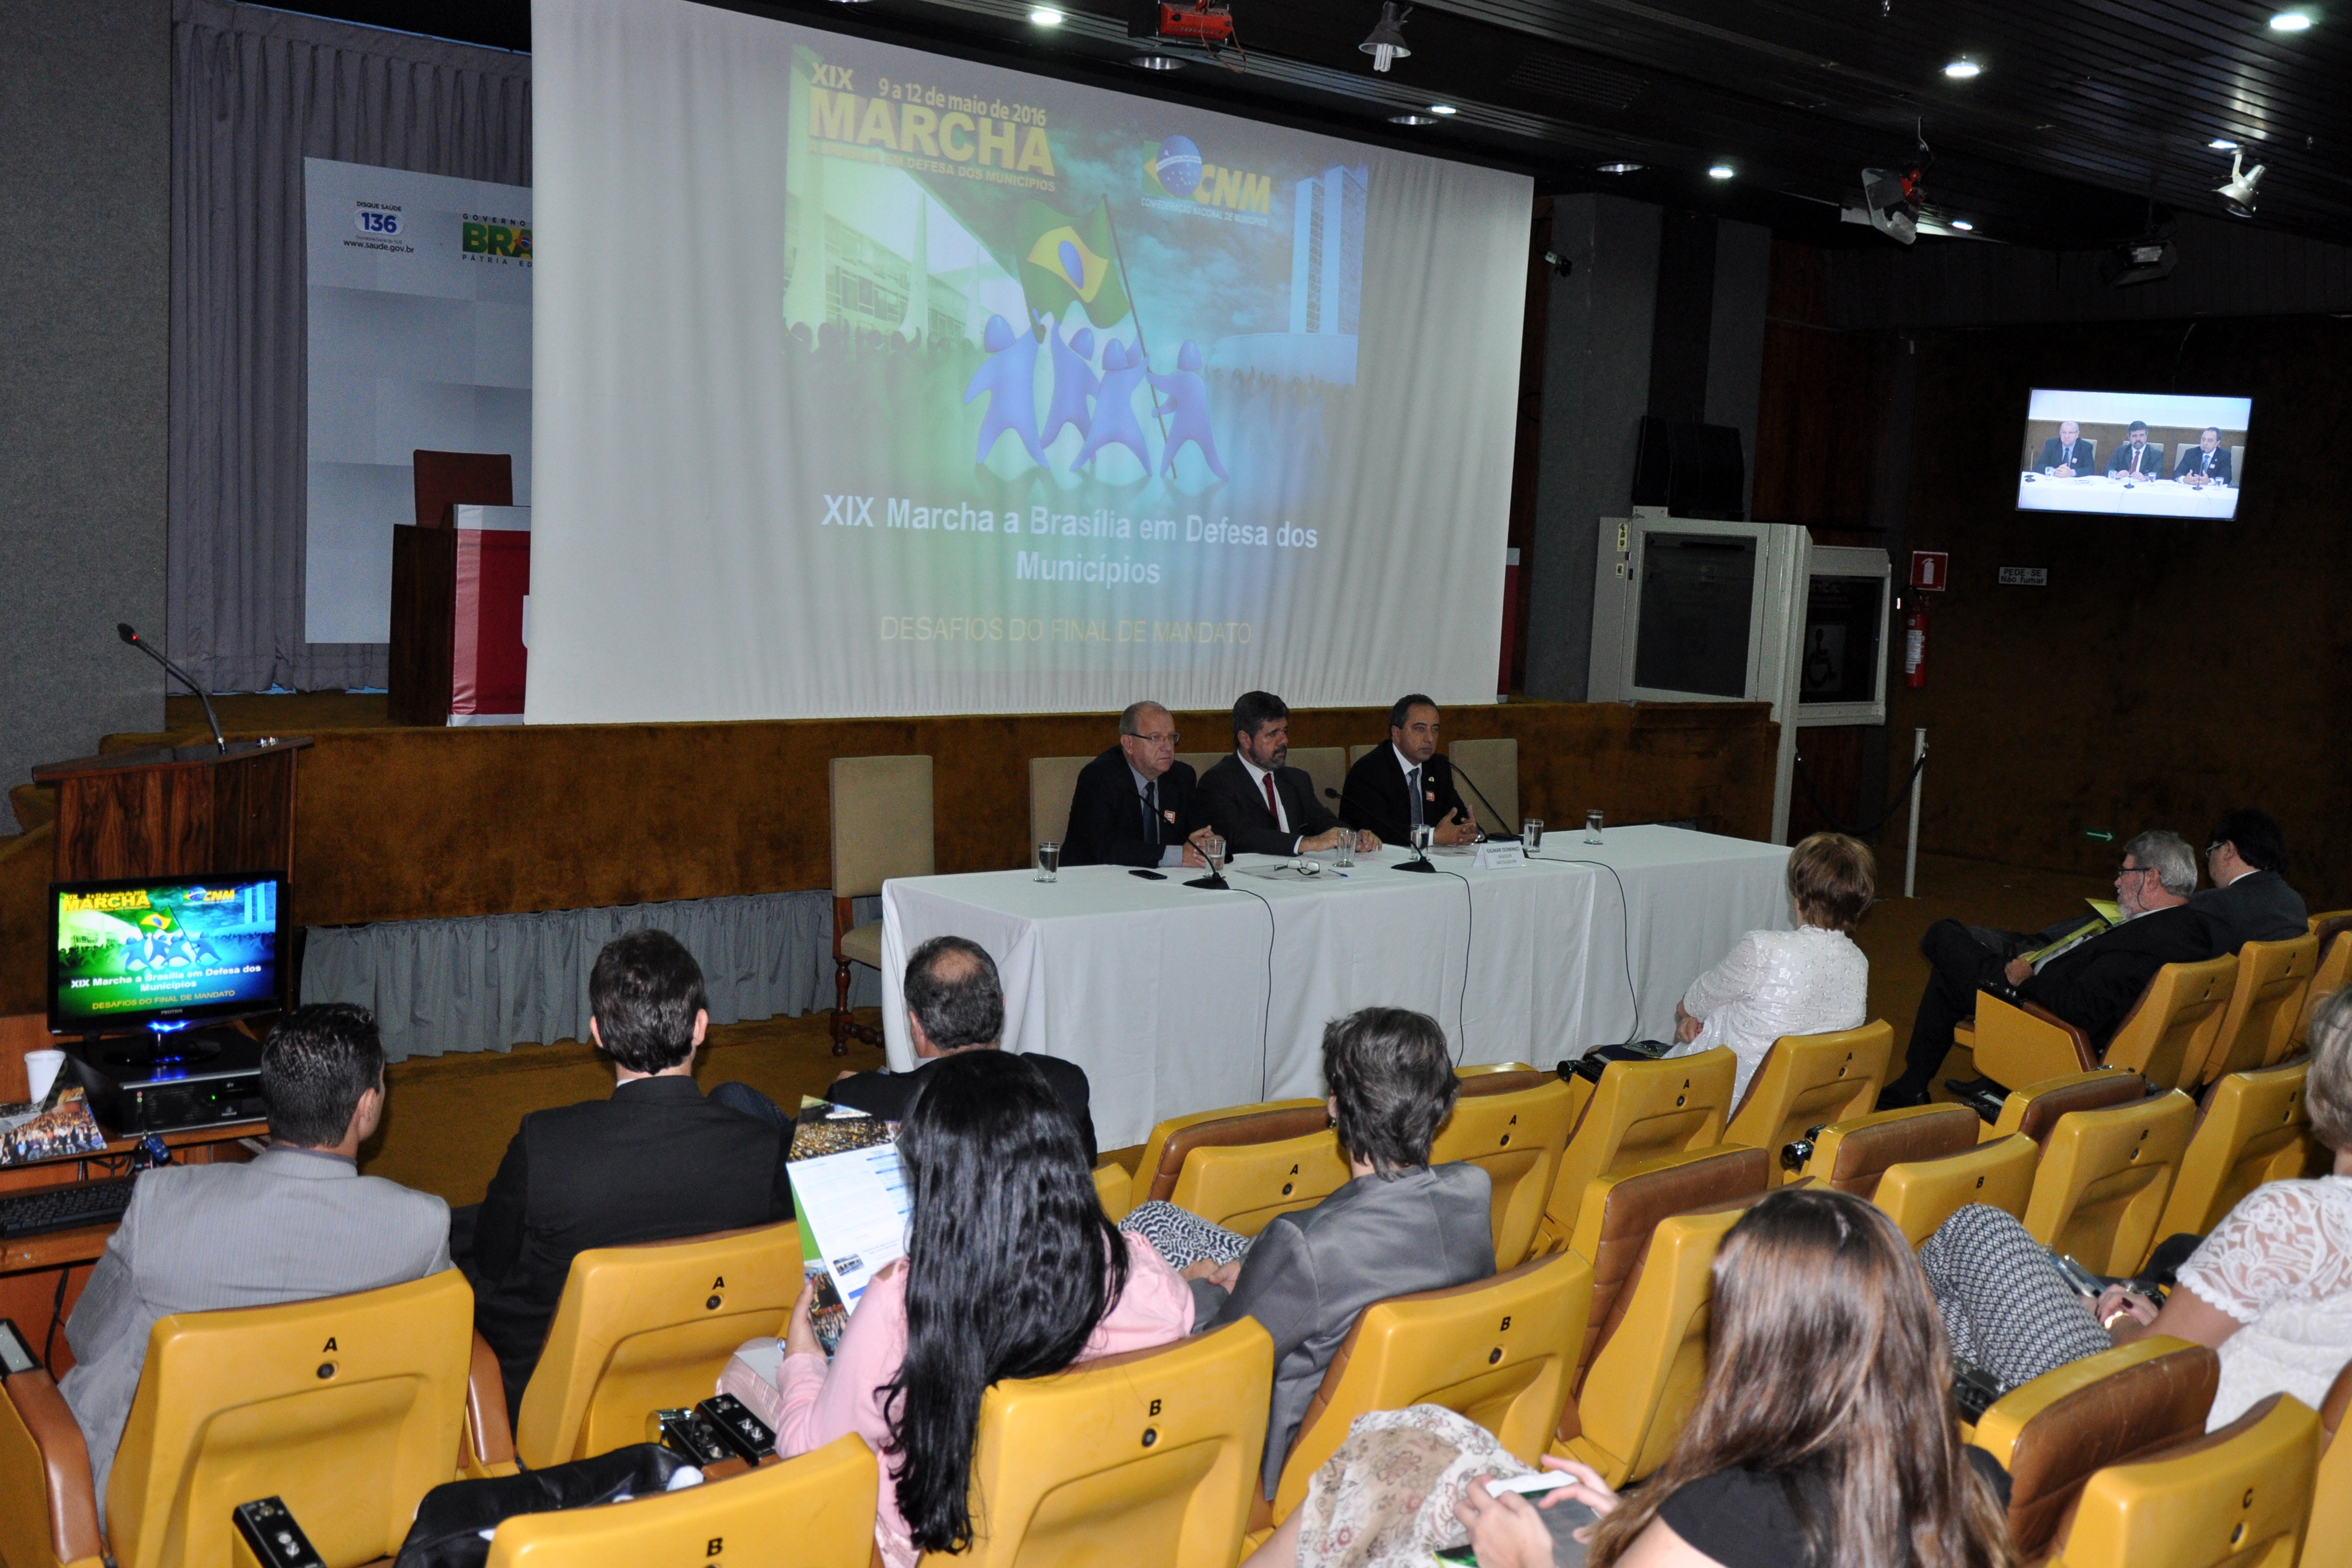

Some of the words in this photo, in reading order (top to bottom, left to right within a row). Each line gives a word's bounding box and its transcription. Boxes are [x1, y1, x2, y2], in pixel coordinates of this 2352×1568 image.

[811, 61, 853, 90] XIX
[879, 78, 889, 96] 9
[892, 84, 901, 99] a
[905, 82, 922, 103] 12
[925, 86, 944, 108] de
[948, 94, 986, 115] maio
[989, 98, 1009, 119] de
[1013, 104, 1047, 127] 2016
[809, 87, 1055, 177] MARCHA
[908, 157, 954, 176] DEFESA
[958, 166, 982, 180] DOS
[986, 171, 1055, 192] MUNICÍPIOS
[1194, 164, 1271, 214] CNM
[357, 201, 380, 209] DISQUE
[381, 203, 402, 212] SAÚDE
[1193, 207, 1223, 220] NACIONAL
[1224, 212, 1233, 221] DE
[361, 212, 397, 233] 136
[463, 213, 526, 227] GOVERNO
[343, 240, 414, 253] www.saude.gov.br
[462, 254, 507, 264] PÁTRIA
[821, 494, 875, 527] XIX
[886, 497, 994, 533] Marcha
[1003, 510, 1019, 534] a
[1031, 505, 1131, 539] Brasília
[1140, 519, 1176, 540] em
[1186, 514, 1268, 546] Defesa
[1276, 520, 1318, 549] dos
[1016, 550, 1160, 589] Municípios
[882, 616, 1002, 641] DESAFIOS
[1009, 617, 1044, 642] DO
[1052, 619, 1111, 643] FINAL
[1118, 620, 1147, 643] DE
[1152, 621, 1253, 645] MANDATO
[64, 895, 151, 911] MARCHA
[204, 889, 235, 902] CNM
[71, 978, 90, 988] XIX
[92, 976, 132, 986] Marcha
[205, 967, 240, 976] Defesa
[242, 965, 261, 973] dos
[92, 999, 137, 1009] DESAFIOS
[154, 995, 179, 1004] FINAL
[194, 989, 235, 999] MANDATO
[1846, 1052, 1852, 1062] A
[1683, 1079, 1690, 1089] A
[1509, 1115, 1517, 1125] A
[2140, 1130, 2150, 1141] B
[1290, 1164, 1298, 1175] A
[1976, 1176, 1985, 1190] B
[712, 1276, 725, 1290] A
[1500, 1316, 1511, 1331] B
[323, 1337, 338, 1353] A
[1149, 1398, 1162, 1417] B
[2243, 1488, 2254, 1509] C
[706, 1537, 723, 1557] B
